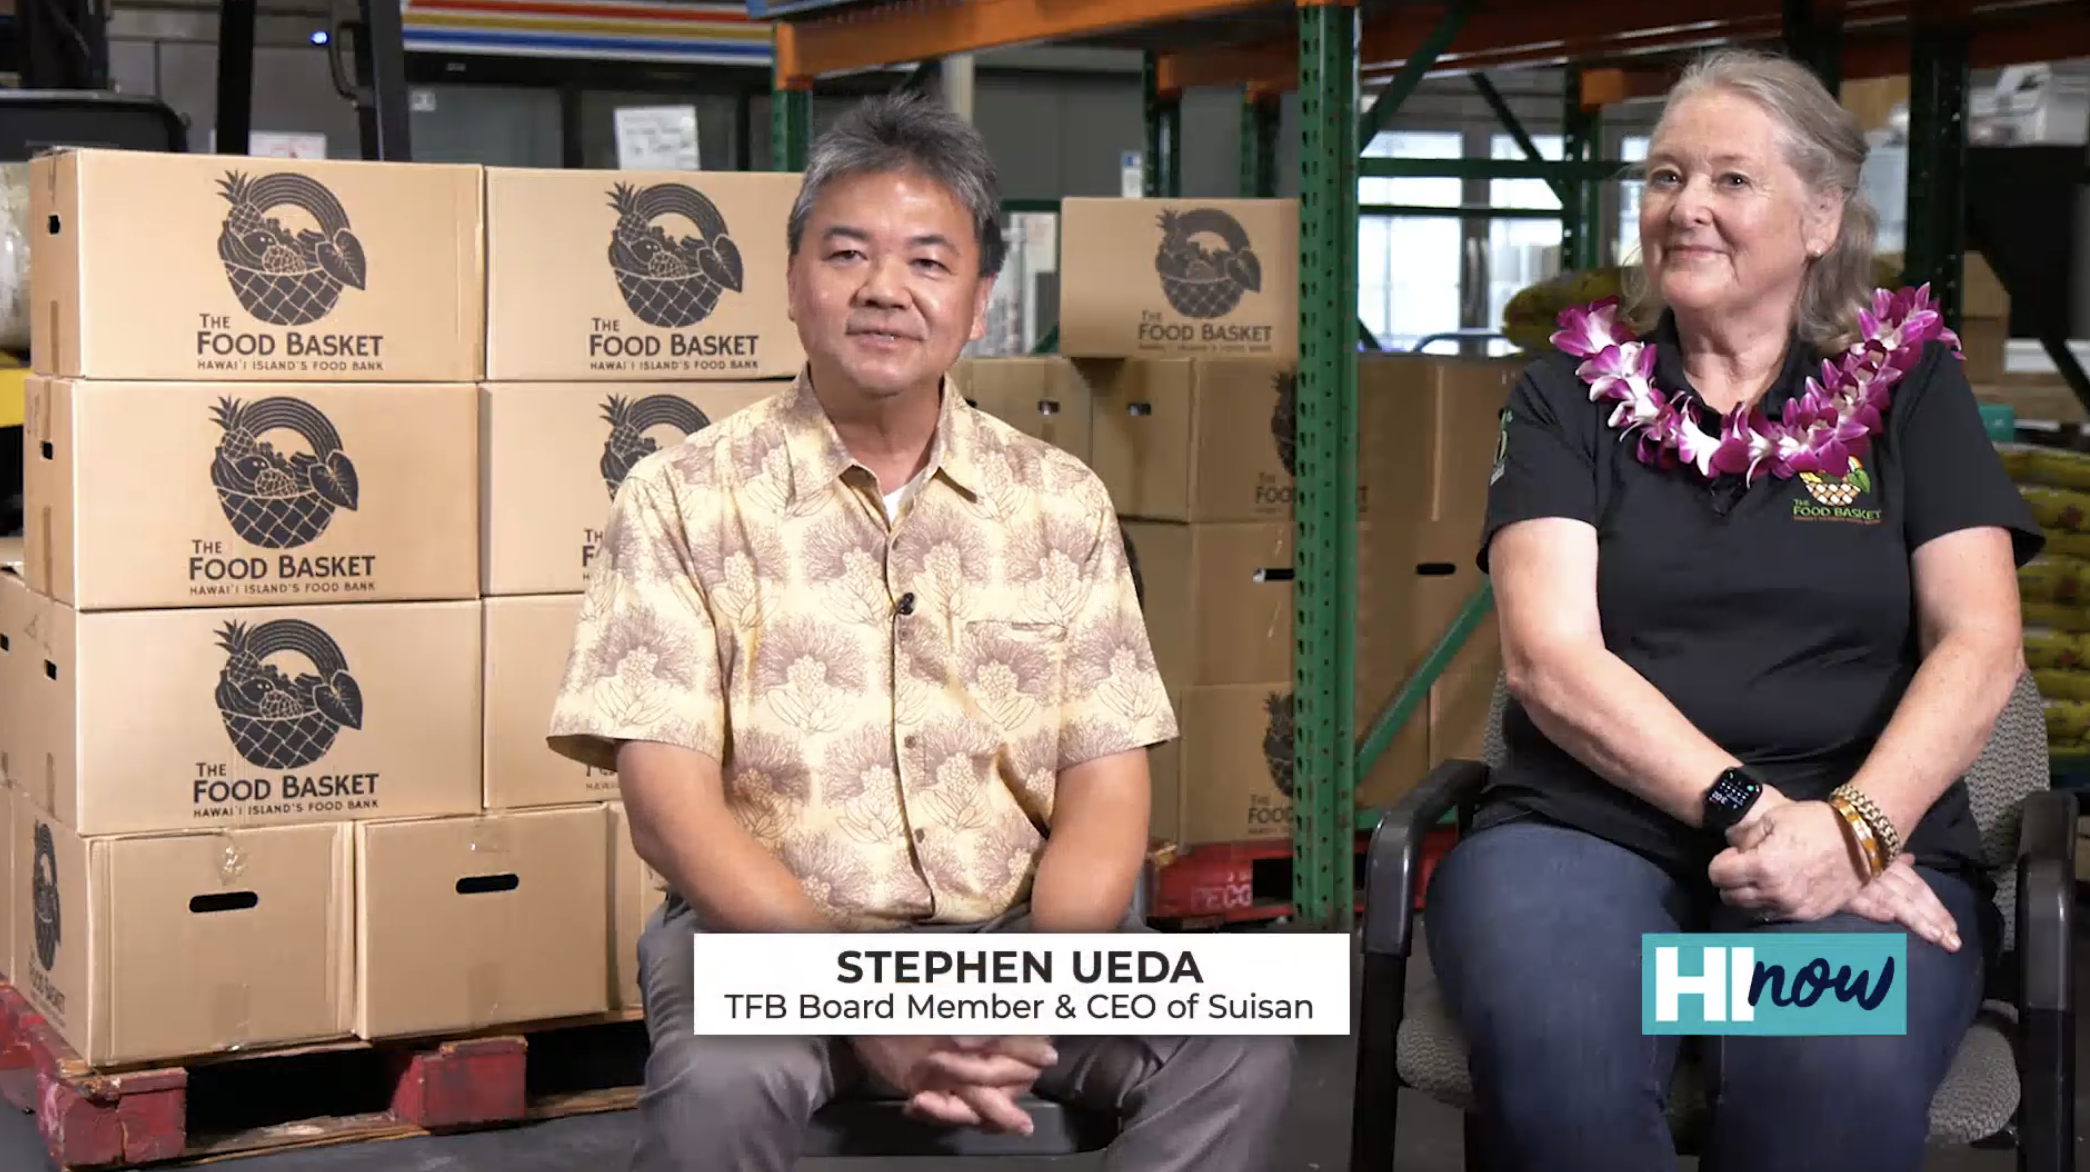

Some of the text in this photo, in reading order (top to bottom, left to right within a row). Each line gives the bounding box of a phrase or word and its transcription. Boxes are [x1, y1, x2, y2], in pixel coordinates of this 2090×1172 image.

[199, 313, 231, 329] THE
[592, 317, 620, 332] THE
[1137, 323, 1273, 342] FOOD BASKET
[197, 331, 384, 356] FOOD BASKET
[589, 334, 759, 357] FOOD BASKET
[313, 361, 347, 371] FOOD
[352, 361, 384, 371] BANK
[694, 361, 726, 370] FOOD
[730, 360, 759, 369] BANK
[1255, 485, 1297, 504] FOO
[1793, 506, 1881, 519] FOOD BASKET
[584, 528, 604, 543] TH
[192, 539, 223, 554] THE
[189, 554, 376, 580] FOOD BASKET
[305, 582, 339, 593] FOOD
[344, 581, 376, 592] BANK
[196, 762, 227, 777] THE
[193, 773, 380, 804] FOOD BASKET
[308, 801, 343, 812] FOOD
[348, 799, 379, 810] BANK
